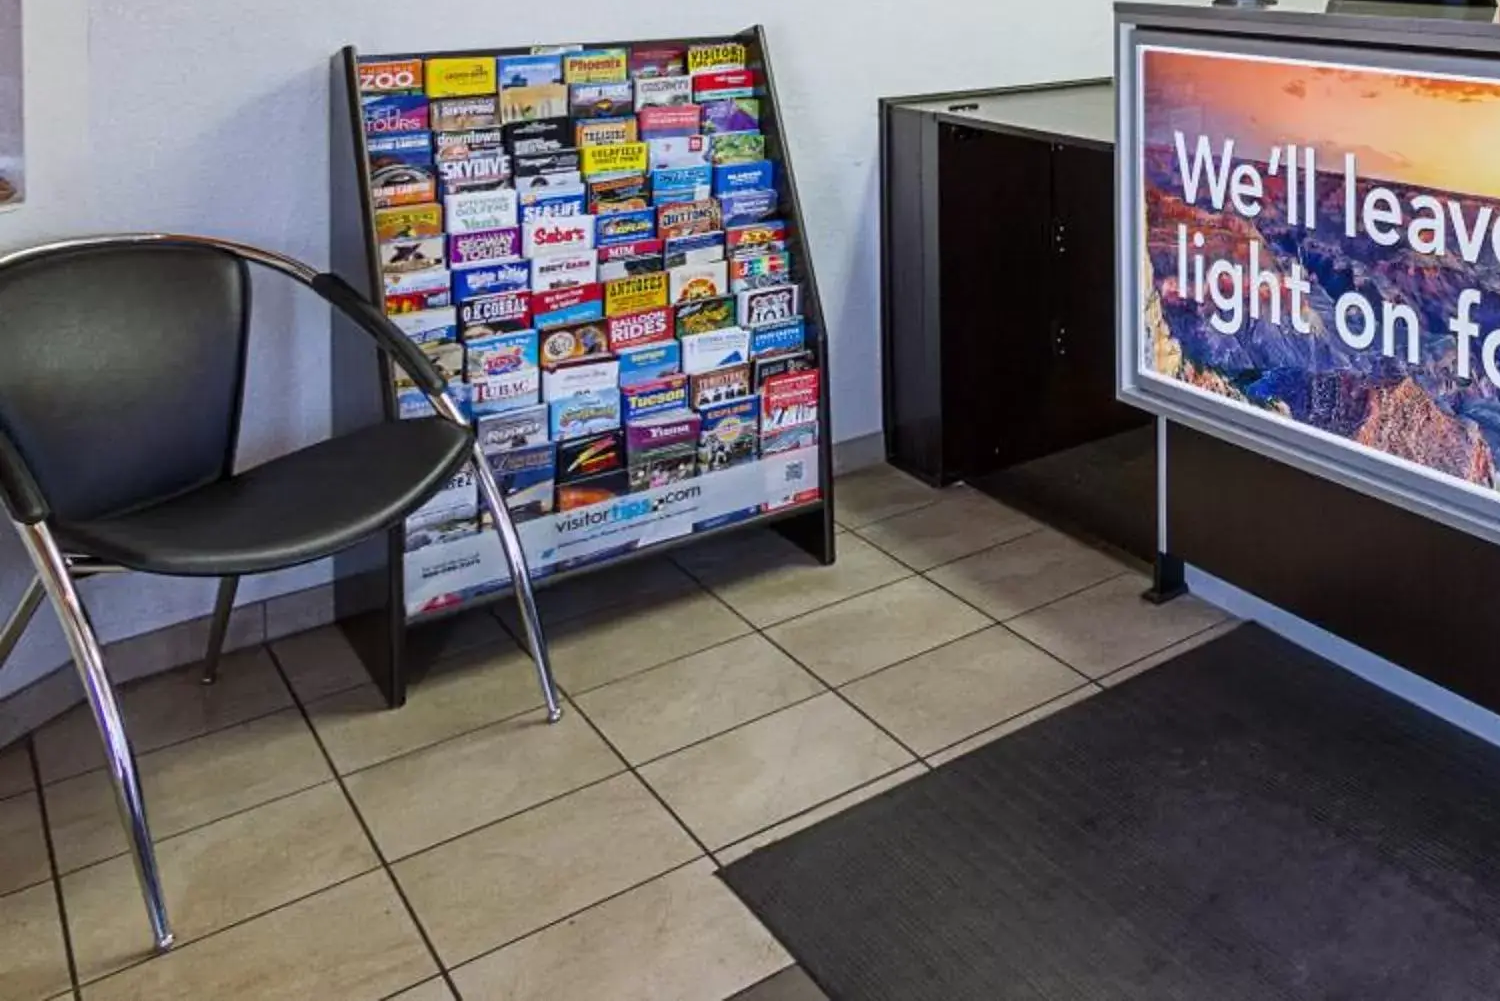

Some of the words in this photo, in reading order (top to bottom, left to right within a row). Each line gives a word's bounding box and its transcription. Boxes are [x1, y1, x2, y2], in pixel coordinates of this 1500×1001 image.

[360, 70, 414, 90] ZOO
[438, 131, 501, 147] downtown
[443, 155, 512, 180] SKYDIVE
[1174, 130, 1316, 230] We'll
[1176, 224, 1311, 336] light
[1335, 294, 1420, 365] on
[611, 310, 666, 329] BALLOON
[611, 318, 667, 343] RIDES
[628, 388, 685, 408] Tucson
